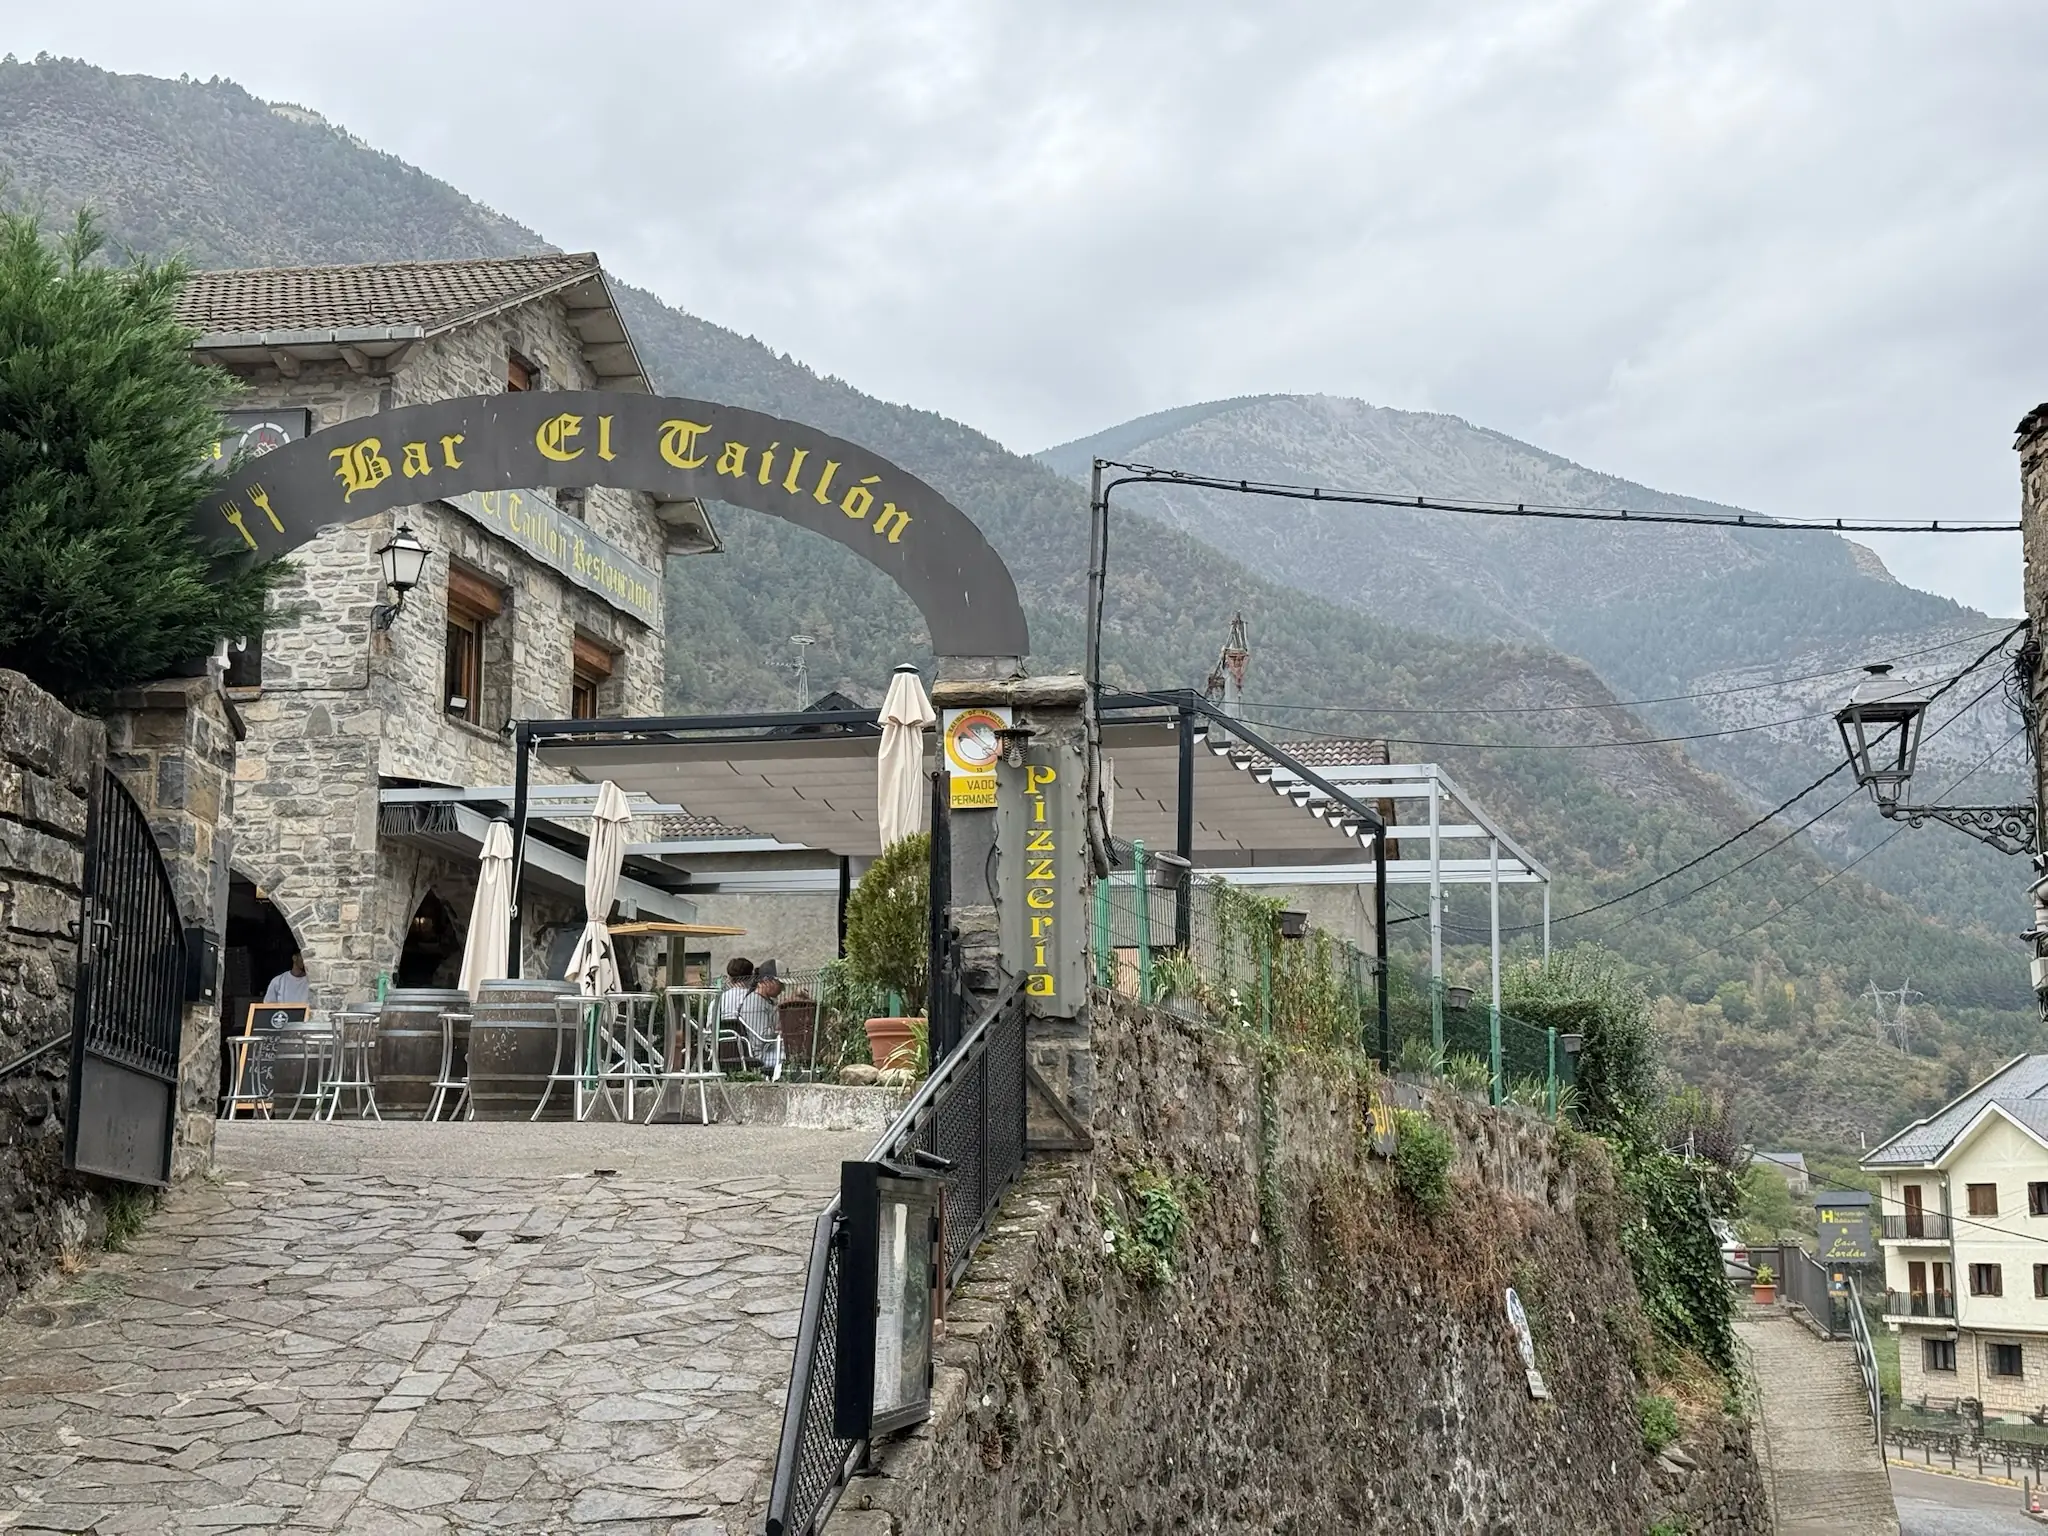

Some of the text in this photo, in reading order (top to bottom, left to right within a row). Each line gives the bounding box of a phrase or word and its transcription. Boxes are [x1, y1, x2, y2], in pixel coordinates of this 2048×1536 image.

[329, 433, 466, 503] Bar
[535, 412, 617, 462] El
[572, 534, 654, 614] Restaurante
[966, 779, 995, 791] VADO
[951, 793, 998, 806] PERMANEN
[1821, 1209, 1834, 1224] H
[1833, 1238, 1857, 1248] Casa
